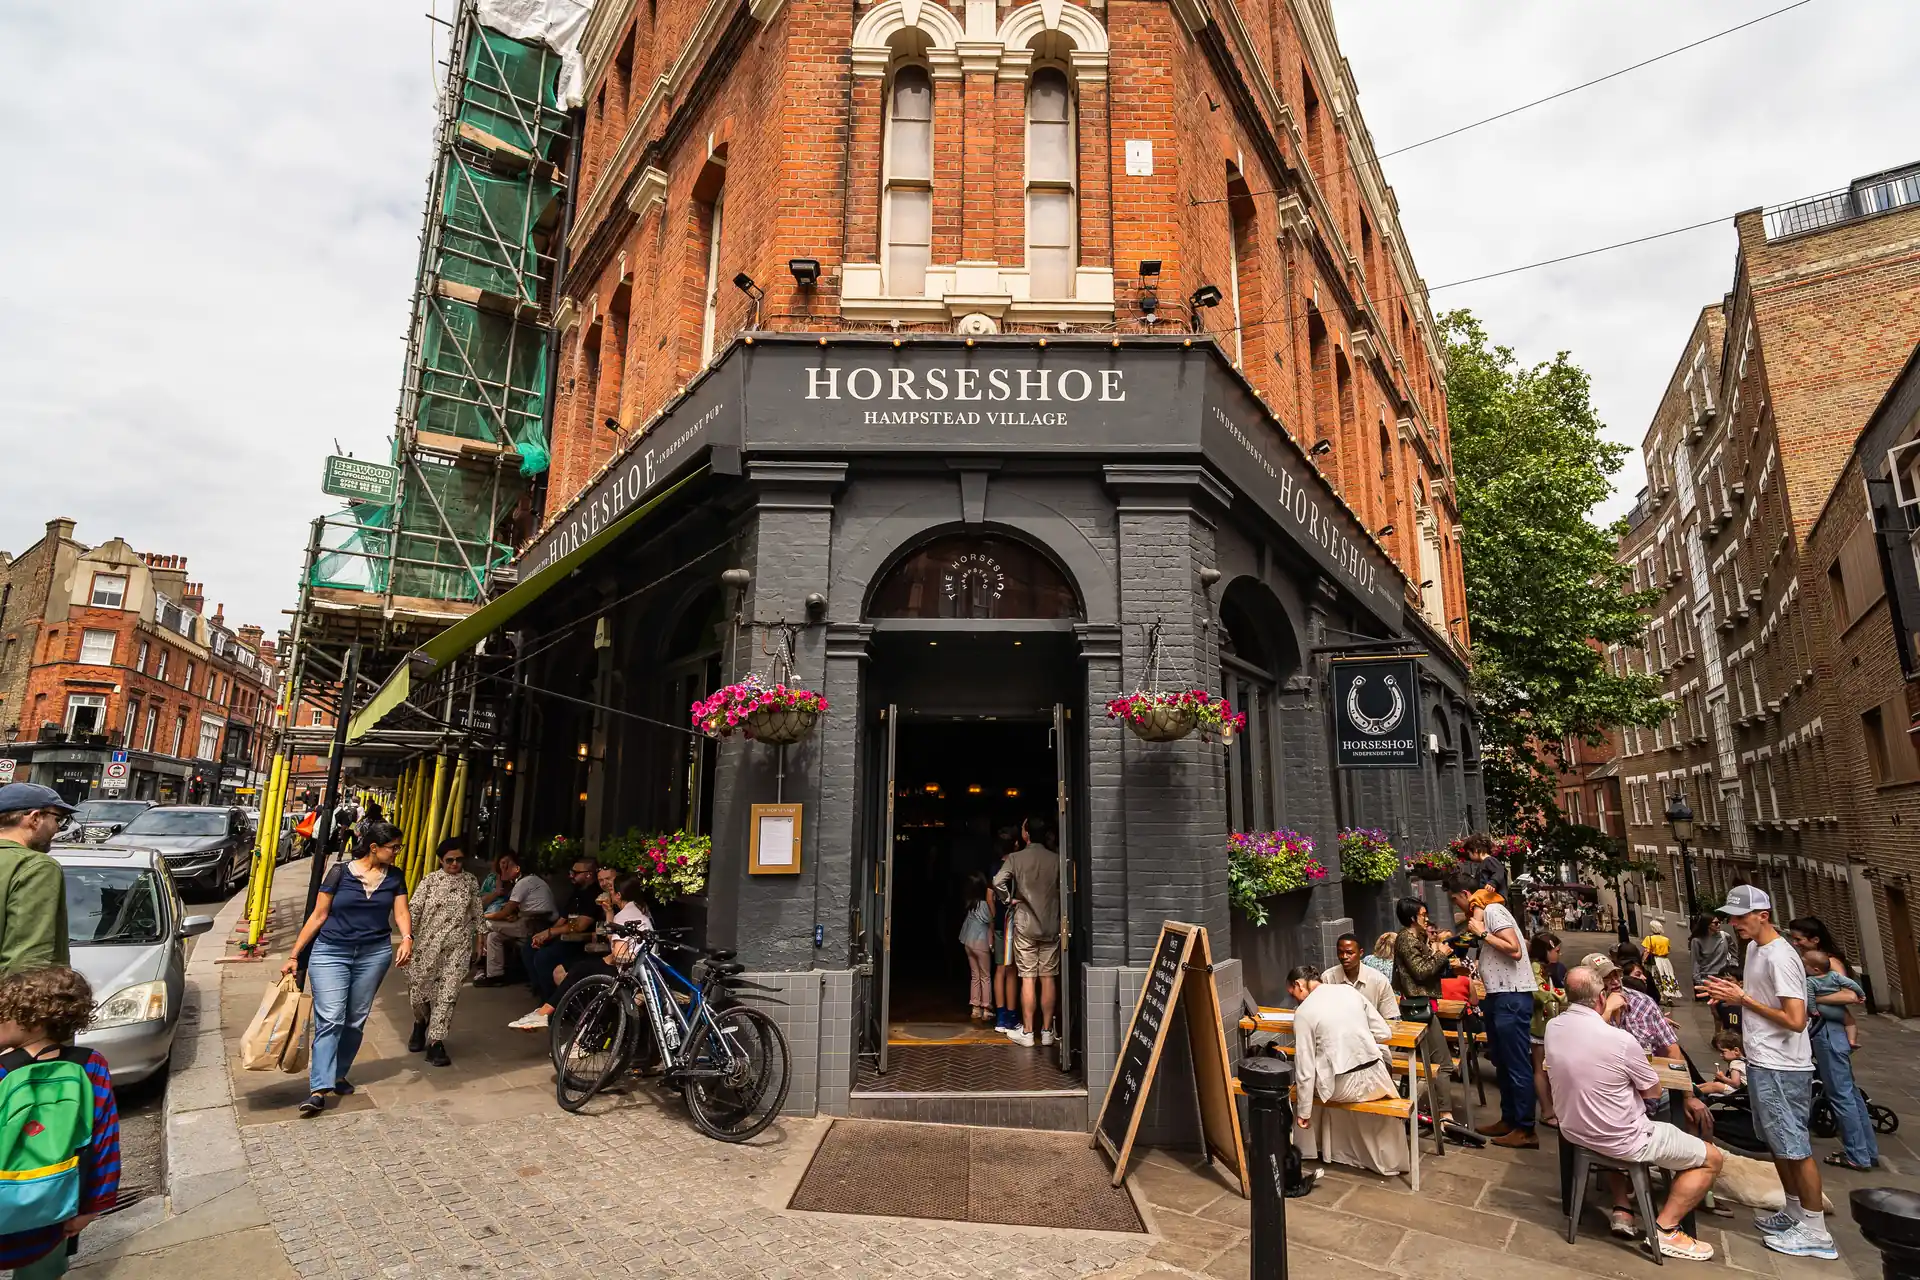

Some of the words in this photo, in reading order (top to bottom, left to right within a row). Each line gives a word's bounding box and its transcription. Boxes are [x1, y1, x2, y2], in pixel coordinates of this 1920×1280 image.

[804, 367, 1126, 402] HORSESHOE
[864, 411, 981, 426] HAMPSTEAD
[985, 411, 1068, 426] VILLAGE
[333, 469, 378, 484] SCAFFOLDING
[334, 460, 392, 479] BERWOOD
[549, 448, 656, 566] HORSESHOE
[659, 418, 704, 464] INDEPENDENT
[705, 404, 720, 424] PUB
[1216, 408, 1263, 464] INDEPENDENT
[1263, 459, 1275, 478] PUB
[1279, 467, 1376, 595] HORSESHOE
[944, 574, 957, 601] THE
[951, 553, 1005, 600] HORSESHOE
[961, 567, 989, 590] HAMPSTEAD
[460, 716, 491, 729] Itlian
[1342, 739, 1415, 750] HORSESHOE
[1352, 750, 1392, 758] INDEPENDENT
[1728, 1012, 1738, 1025] 10
